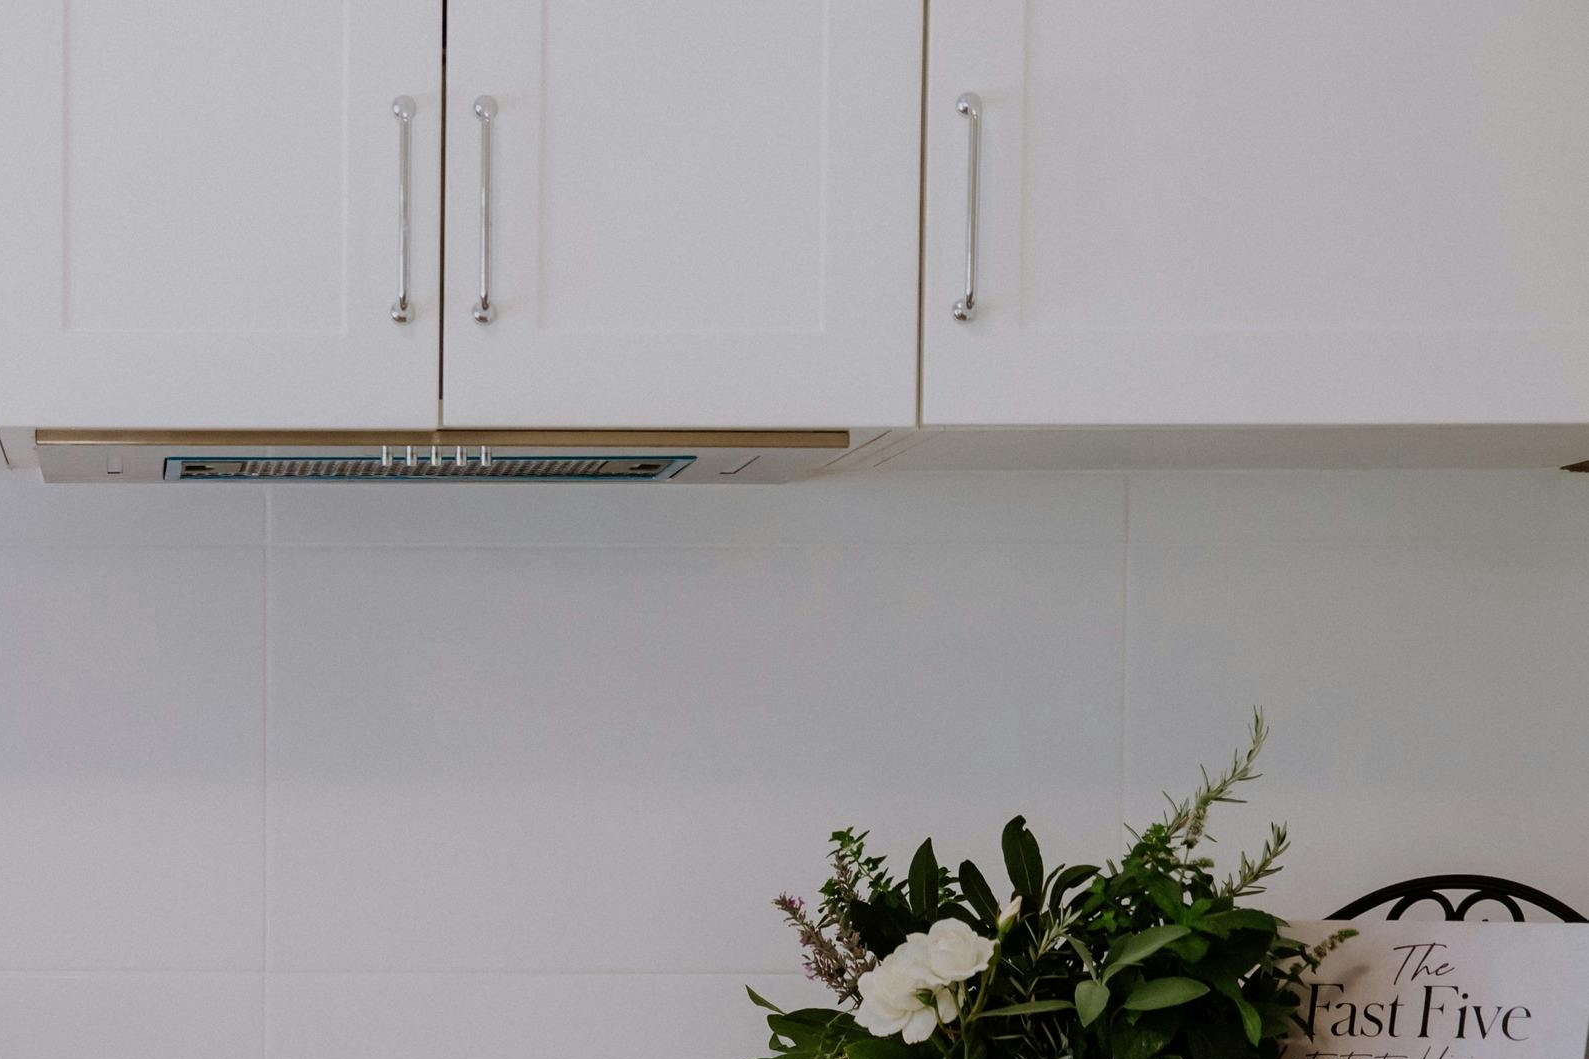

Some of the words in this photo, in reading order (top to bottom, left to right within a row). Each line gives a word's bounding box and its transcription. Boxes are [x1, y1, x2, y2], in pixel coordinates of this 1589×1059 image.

[1393, 942, 1455, 985] The
[1307, 983, 1404, 1038] Fast
[1417, 985, 1532, 1041] Five
